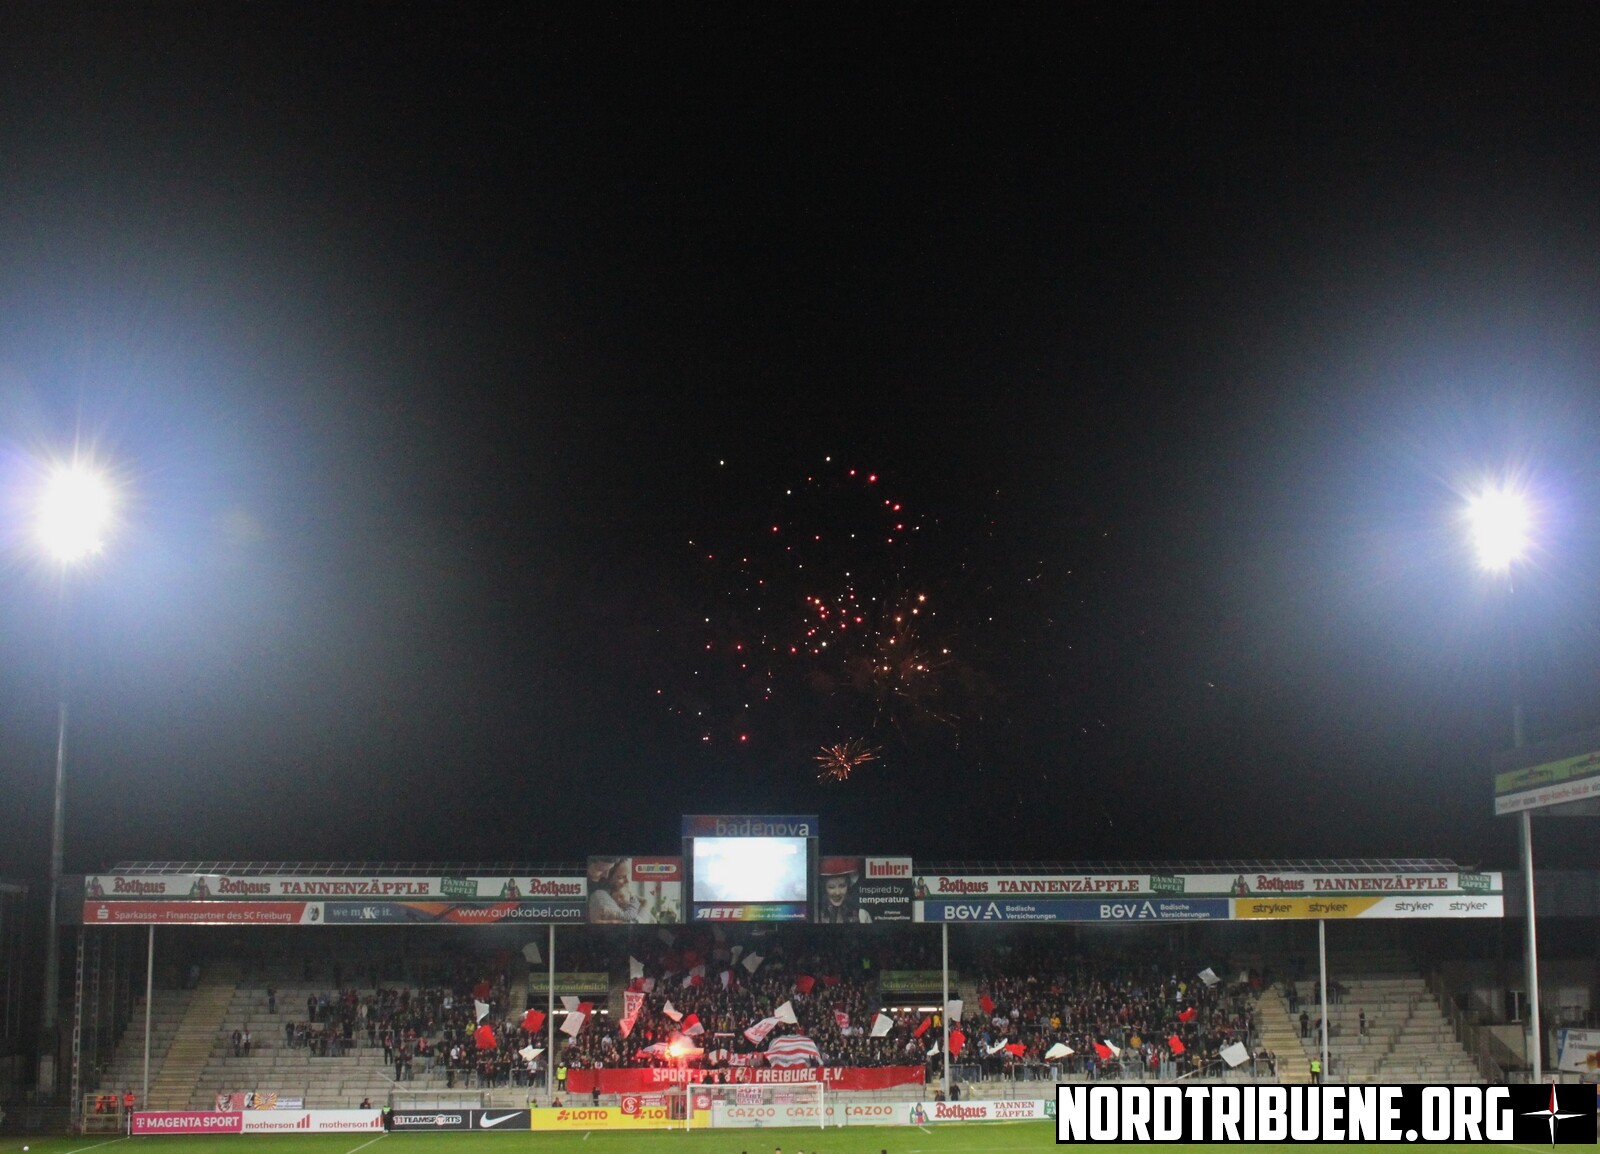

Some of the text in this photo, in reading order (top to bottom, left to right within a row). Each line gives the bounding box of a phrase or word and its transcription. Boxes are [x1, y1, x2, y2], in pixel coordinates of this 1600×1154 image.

[716, 819, 809, 836] badenova
[870, 861, 909, 876] huber
[1151, 875, 1183, 884] TANNEN
[1256, 875, 1448, 892] Rothaus TANNENZÄPFLE
[113, 877, 166, 896] Rothaus
[218, 877, 430, 896] Rothaus TANNENZÄPFLE
[529, 878, 581, 896] Rothaus
[859, 886, 904, 895] Inspired by
[937, 877, 1139, 895] Rothaus TANNENZÄPFLE
[944, 905, 981, 919] BGV
[1100, 904, 1137, 918] BGV
[1252, 903, 1292, 914] stryker
[1308, 903, 1348, 913] stryker
[1394, 902, 1434, 912] stryker
[1449, 901, 1488, 912] stryker
[115, 911, 157, 921] Sparkasse
[166, 911, 224, 921] Finanzpartner
[226, 911, 242, 919] des
[244, 911, 255, 919] SC
[256, 911, 292, 921] Freiburg
[458, 907, 581, 918] www.autokabel.com
[1006, 913, 1056, 921] Versicherungen
[755, 1067, 816, 1082] FREIBURG
[823, 1067, 844, 1081] E.V.
[845, 1106, 892, 1115] CAZOO
[994, 1101, 1034, 1109] TANNEN
[572, 1110, 608, 1120] LOTTO
[727, 1107, 775, 1117] CAZOO
[935, 1102, 987, 1120] Rothaus
[996, 1109, 1034, 1118] ZÄPFLE
[147, 1116, 201, 1128] MAGENTA
[203, 1116, 239, 1128] SPORT
[246, 1121, 294, 1129] motherson
[319, 1120, 368, 1128] motherson
